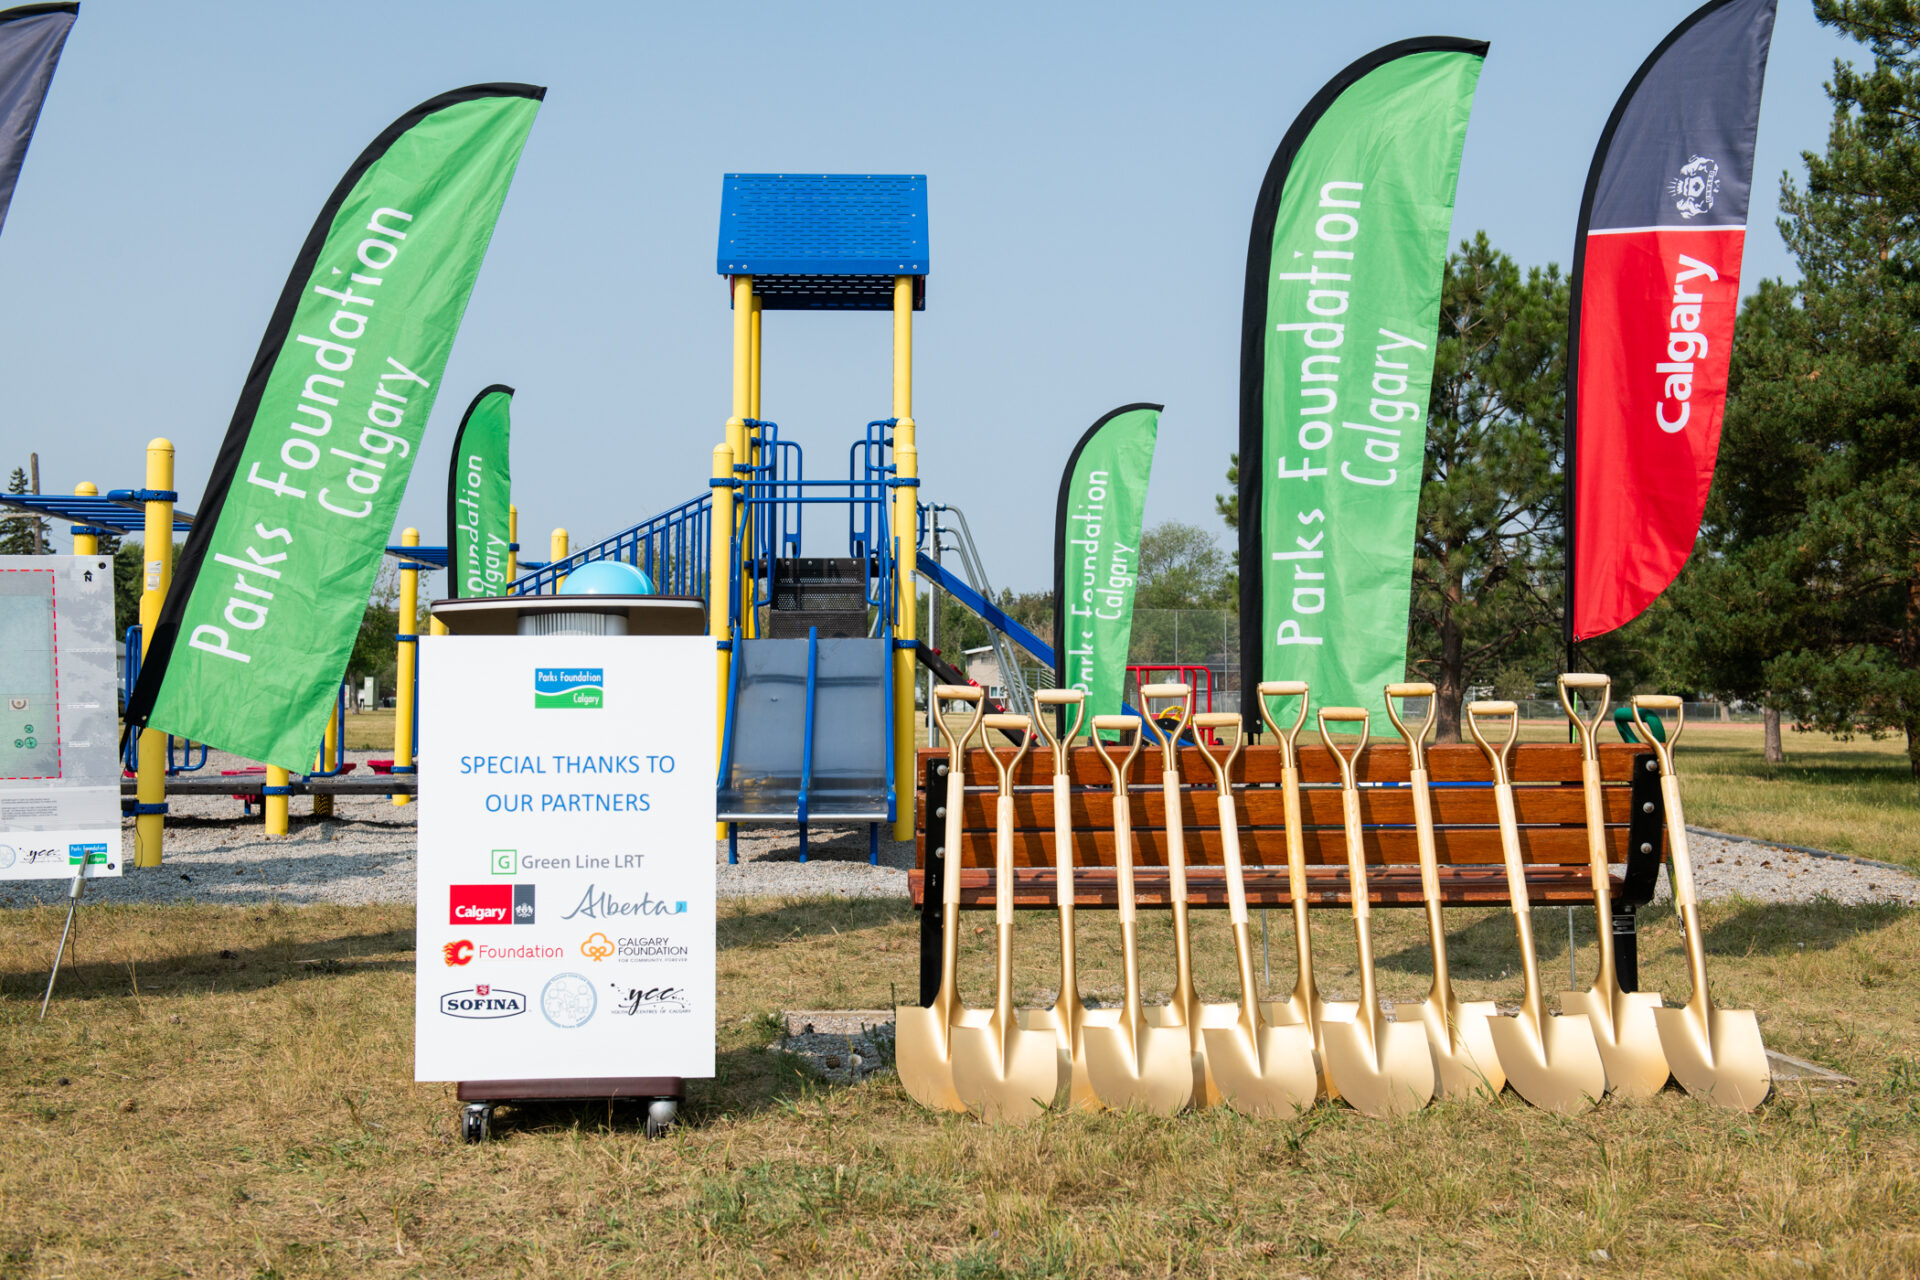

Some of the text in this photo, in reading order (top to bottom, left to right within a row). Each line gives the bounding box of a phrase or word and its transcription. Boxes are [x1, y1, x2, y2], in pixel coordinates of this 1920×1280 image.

[1656, 254, 1719, 434] Calgary
[1272, 180, 1363, 646] Parks Foundation
[1340, 327, 1428, 487] Calgary
[188, 206, 413, 663] Parks Foundation
[318, 356, 430, 519] Calgary
[458, 455, 484, 598] oundation
[1070, 470, 1109, 618] Foundation
[485, 533, 507, 598] algary
[1095, 541, 1135, 620] Calgary
[537, 670, 602, 682] Parks Foundation
[573, 692, 600, 705] Calgary
[460, 755, 675, 774] SPECIAL THANKS TO
[485, 793, 651, 812] OUR PARTNERS
[498, 854, 645, 870] G Green Line LRT
[455, 905, 507, 921] Calgary
[560, 884, 684, 920] Alberta
[479, 945, 564, 958] Foundation
[618, 937, 669, 947] CALGARY
[618, 946, 688, 956] FOUNDATION
[447, 999, 520, 1010] SOFINA
[628, 987, 675, 1016] ycc
